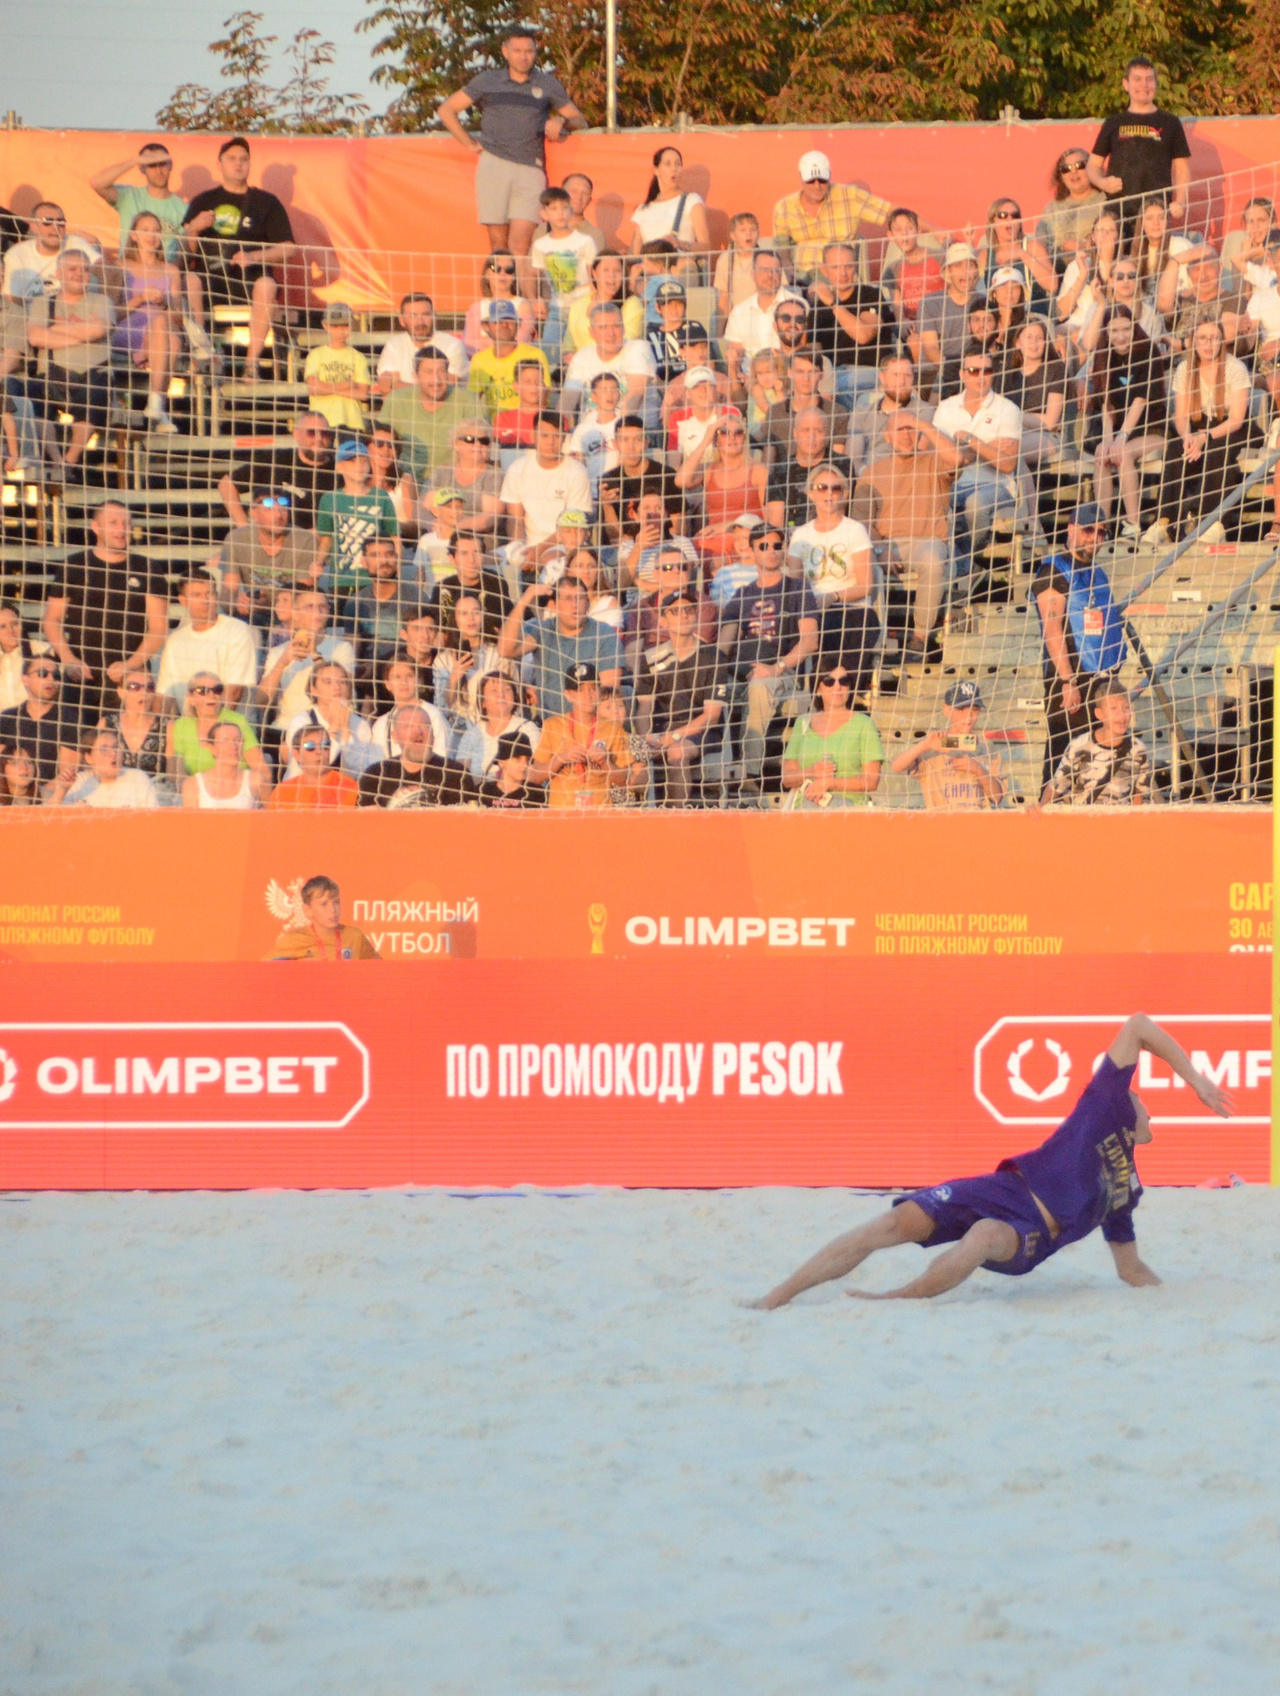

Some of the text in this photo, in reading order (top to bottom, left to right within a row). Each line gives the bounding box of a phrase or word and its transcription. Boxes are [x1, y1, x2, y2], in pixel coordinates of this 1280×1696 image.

[62, 905, 121, 923] РОССИИ
[353, 897, 479, 922] ПЛЯЖНЫЙ
[625, 915, 856, 947] OLIMPBET
[875, 914, 1028, 932] ЧЕМПИОНАТ РОССИИ
[1229, 917, 1252, 938] 30
[87, 927, 155, 945] ФУТБОЛУ
[366, 932, 450, 954] УТБОЛ
[875, 936, 1063, 955] ПО ПЛЯЖНОМУ ФУТБОЛУ
[37, 1056, 338, 1095] OLIMPBET
[446, 1040, 845, 1103] ПО ПРОМОКОДУ PESOK
